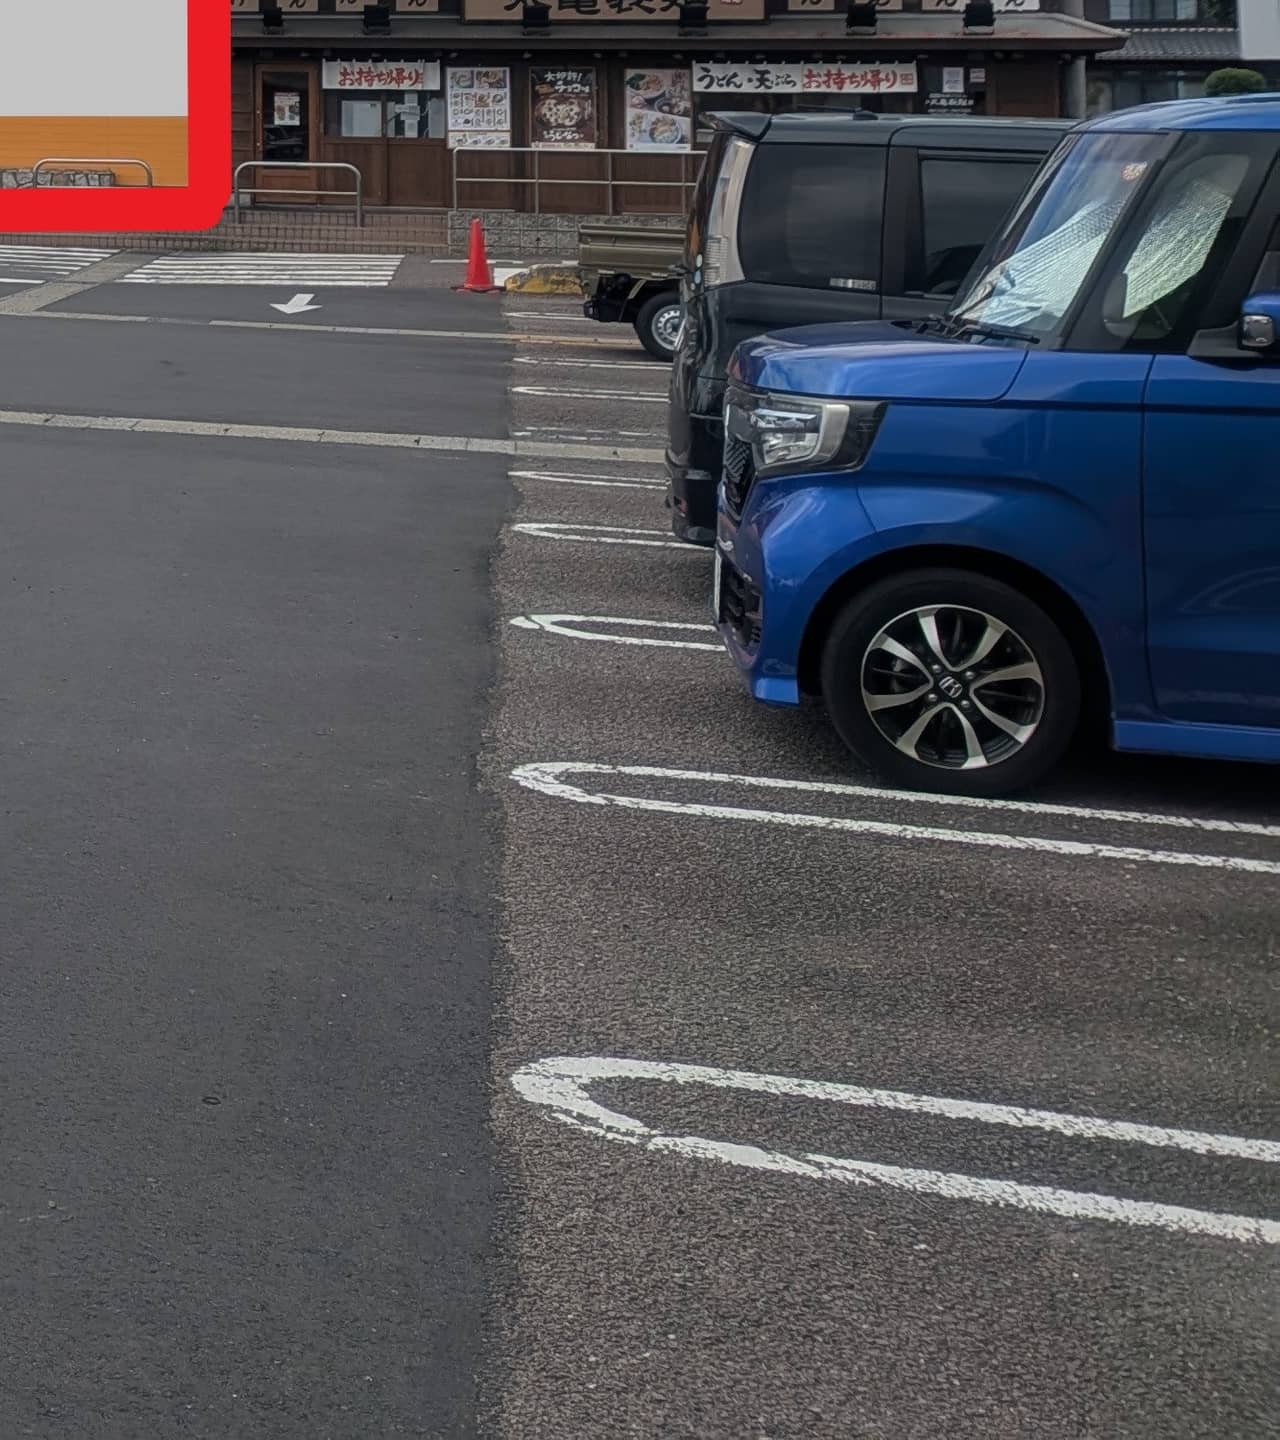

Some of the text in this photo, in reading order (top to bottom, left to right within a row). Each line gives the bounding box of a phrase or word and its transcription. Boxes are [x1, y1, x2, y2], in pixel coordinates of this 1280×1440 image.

[338, 67, 420, 88] お持ち帰り
[802, 68, 898, 93] お持ち帰り
